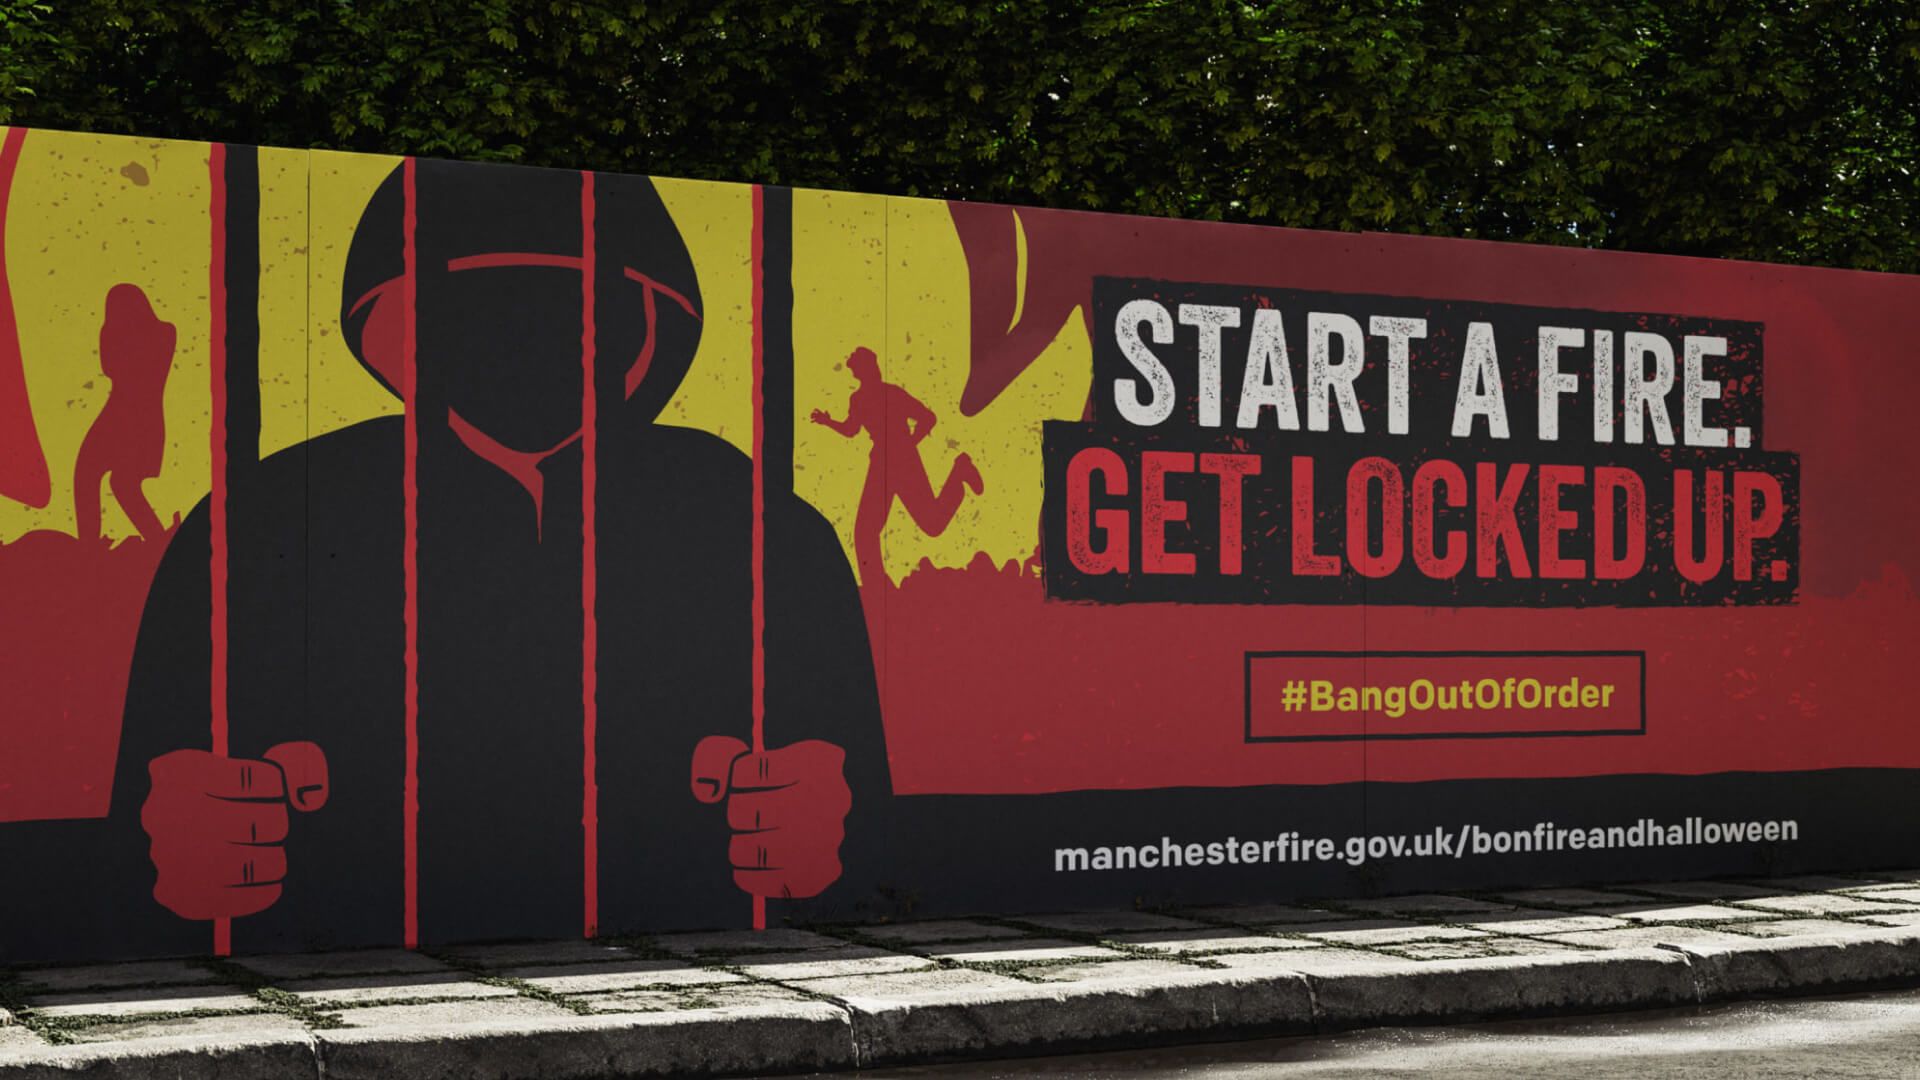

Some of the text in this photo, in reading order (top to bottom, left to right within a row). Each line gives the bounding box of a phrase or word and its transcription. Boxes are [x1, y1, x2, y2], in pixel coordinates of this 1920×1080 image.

[1114, 299, 1752, 448] START A FIRE.
[1065, 447, 1787, 583] GET LOCKED UP.
[1281, 677, 1616, 718] #BangOutOfOrder
[1054, 816, 1799, 872] manchesterfire.gov.uk/bonfireandhalloween
